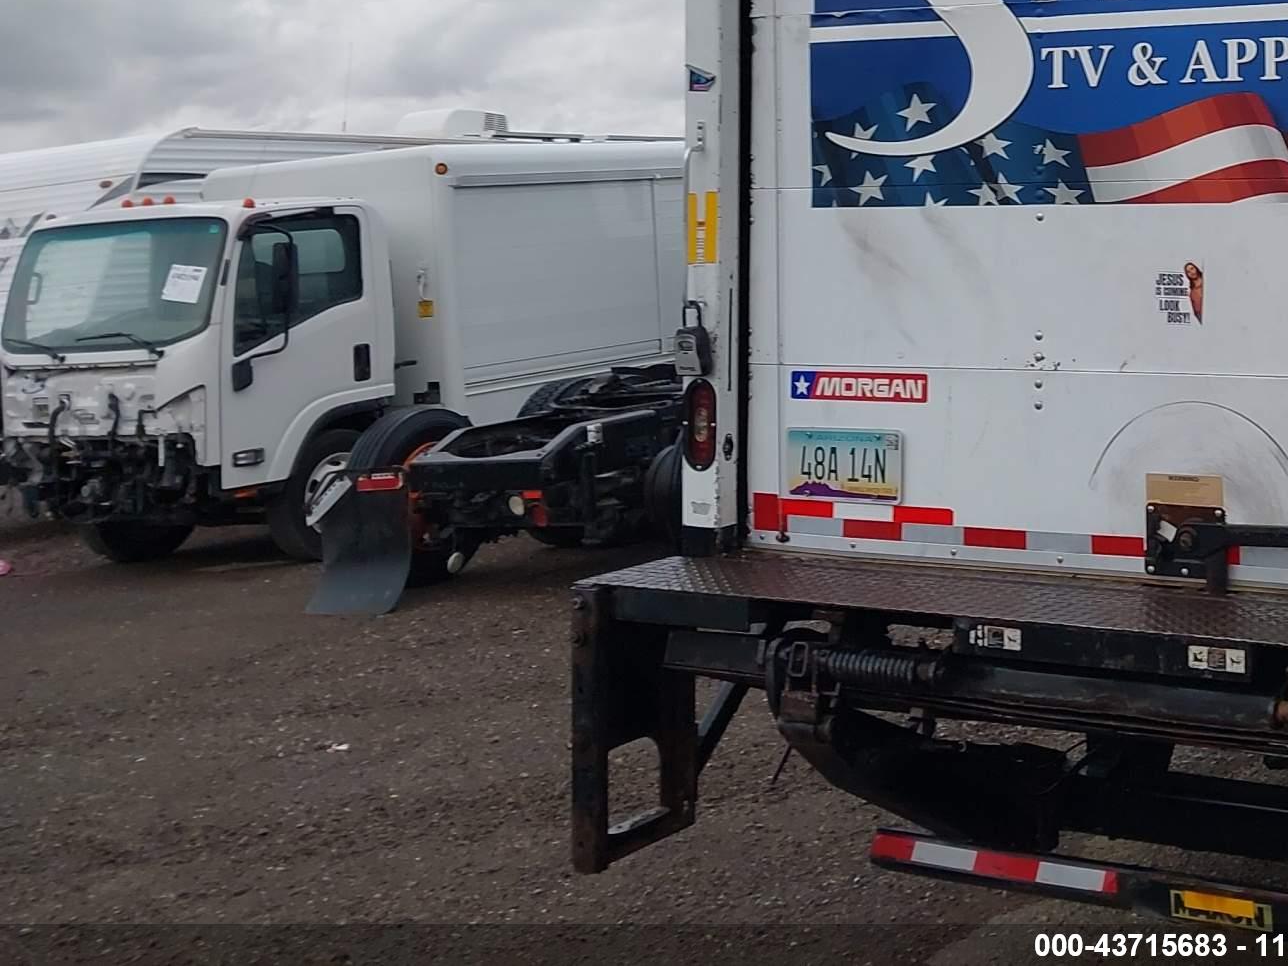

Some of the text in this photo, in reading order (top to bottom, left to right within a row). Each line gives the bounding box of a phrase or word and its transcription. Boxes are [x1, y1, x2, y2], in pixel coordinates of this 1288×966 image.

[1040, 44, 1115, 89] TV
[1127, 42, 1168, 86] &
[1156, 273, 1184, 286] JESUS
[1160, 299, 1180, 311] LOOK
[815, 377, 923, 399] MORGAN
[801, 446, 886, 483] 48A 14N
